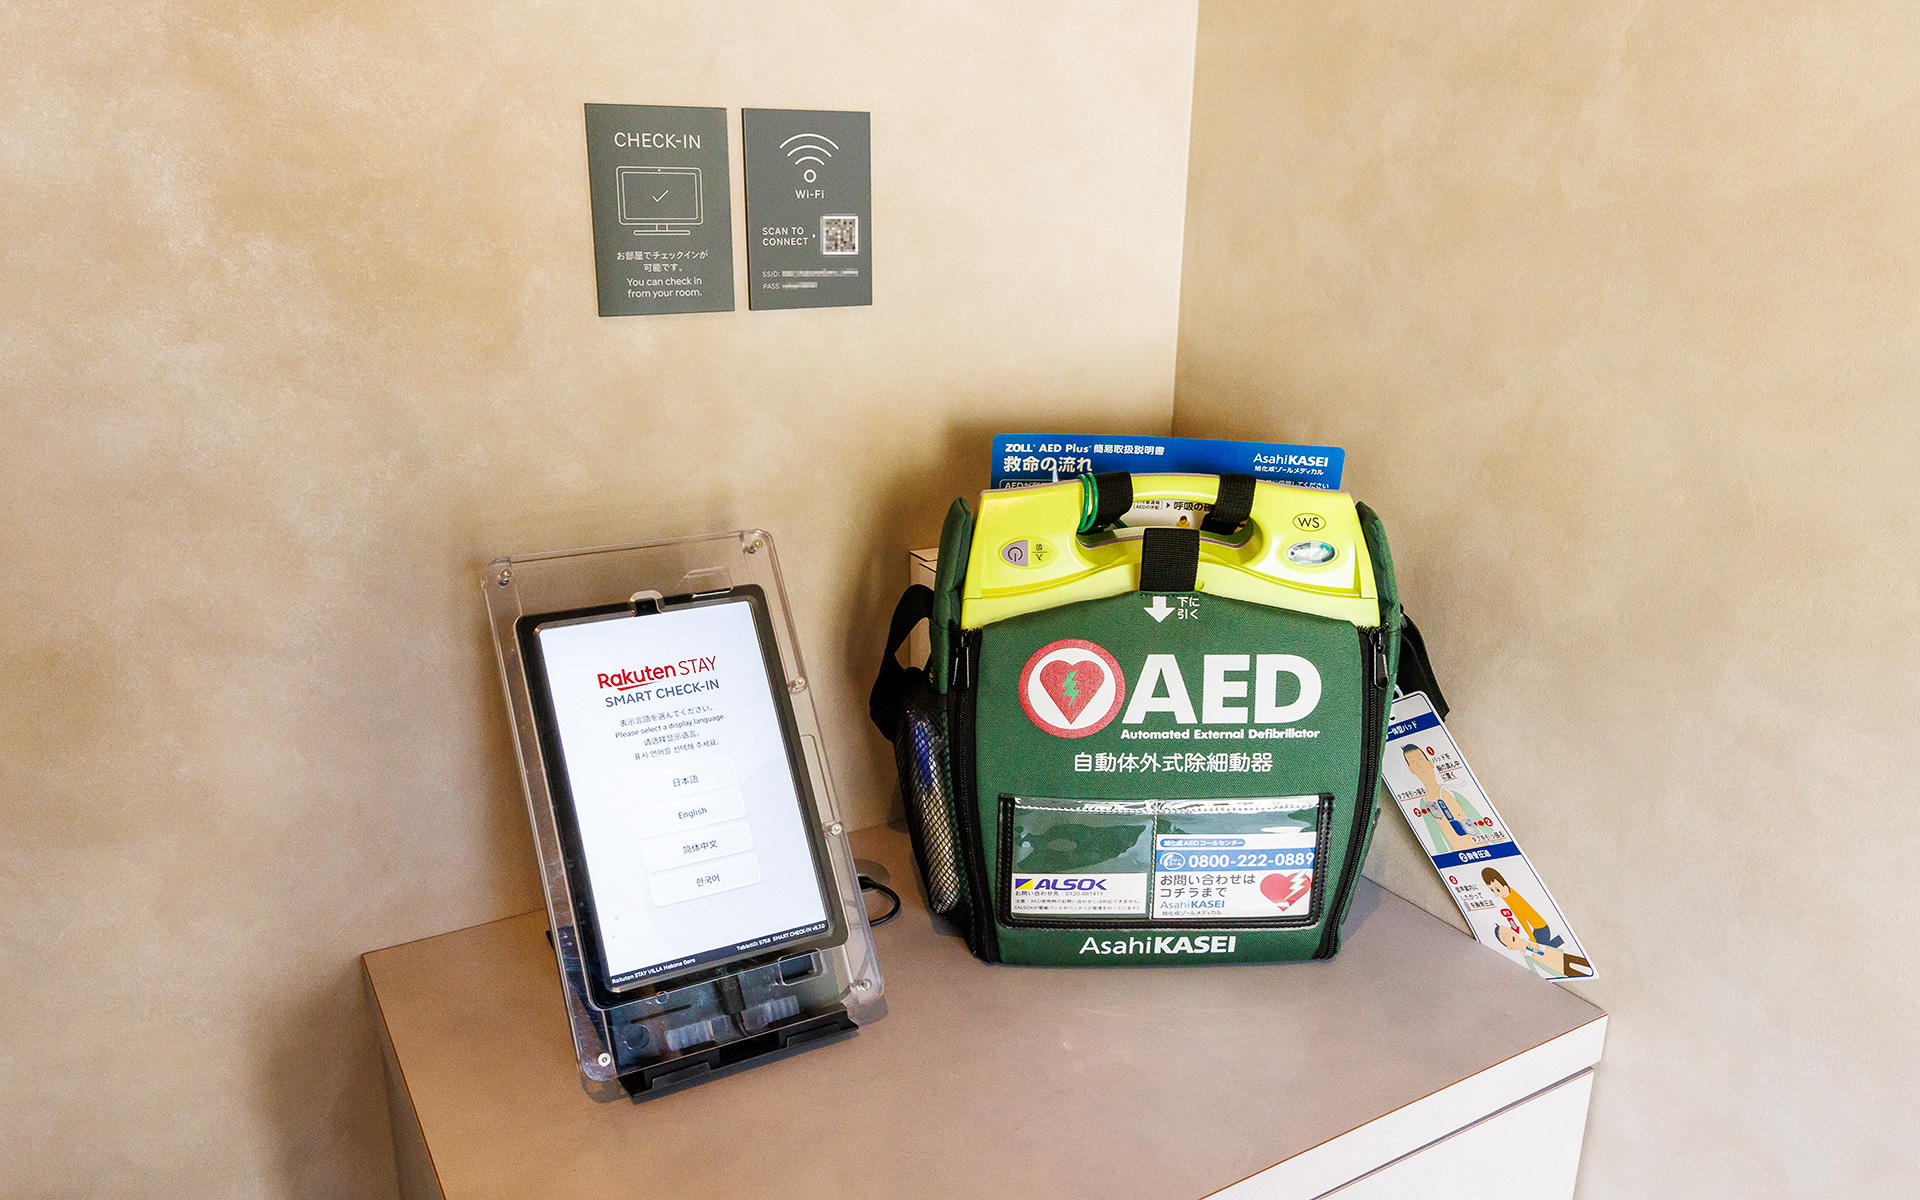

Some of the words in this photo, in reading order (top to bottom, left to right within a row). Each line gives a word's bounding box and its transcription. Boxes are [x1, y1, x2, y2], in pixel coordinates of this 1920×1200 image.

[614, 132, 701, 149] CHECK-IN
[795, 189, 825, 199] Wi-Fi
[762, 227, 788, 236] SCAN
[791, 227, 804, 235] TO
[762, 237, 809, 246] CONNECT
[616, 250, 708, 260] お部屋でチェックインが
[643, 263, 682, 272] 可能です。
[626, 278, 644, 287] You
[646, 279, 663, 287] can
[664, 277, 692, 286] check
[693, 277, 702, 285] in
[627, 289, 651, 298] from
[652, 290, 673, 299] your
[675, 288, 702, 297] room.
[1038, 443, 1062, 453] AED
[1093, 444, 1165, 456] 簡易取扱説明書
[1003, 456, 1093, 473] 救命の流れ
[1253, 453, 1329, 467] AsahiKASEI
[1298, 517, 1320, 528] WS
[1177, 596, 1200, 607] 下に
[1177, 608, 1198, 619] 引く
[597, 665, 677, 690] Rakuten
[678, 655, 716, 676] STAY
[605, 690, 652, 708] SMART
[656, 679, 720, 699] CHECK-IN
[1121, 653, 1322, 725] AED
[615, 729, 640, 739] Please
[640, 724, 662, 735] select
[668, 719, 693, 731] display
[1120, 728, 1190, 740] Automated
[1193, 728, 1244, 740] External
[1247, 728, 1320, 740] Defibrillator
[1073, 751, 1273, 773] 自動体外式除細動器
[672, 774, 699, 787] 日本語
[678, 806, 708, 819] English
[682, 839, 718, 854] 简体中文
[1188, 852, 1315, 868] 0800-222-0889
[696, 873, 721, 887] 한국어
[1034, 878, 1107, 890] ALSOK
[1160, 874, 1256, 886] お問い合わせは
[1160, 887, 1227, 898] コチラまで
[1160, 900, 1225, 909] AsahiKASEI
[1079, 935, 1237, 954] AsahiKASEI
[611, 974, 635, 984] Rakuten
